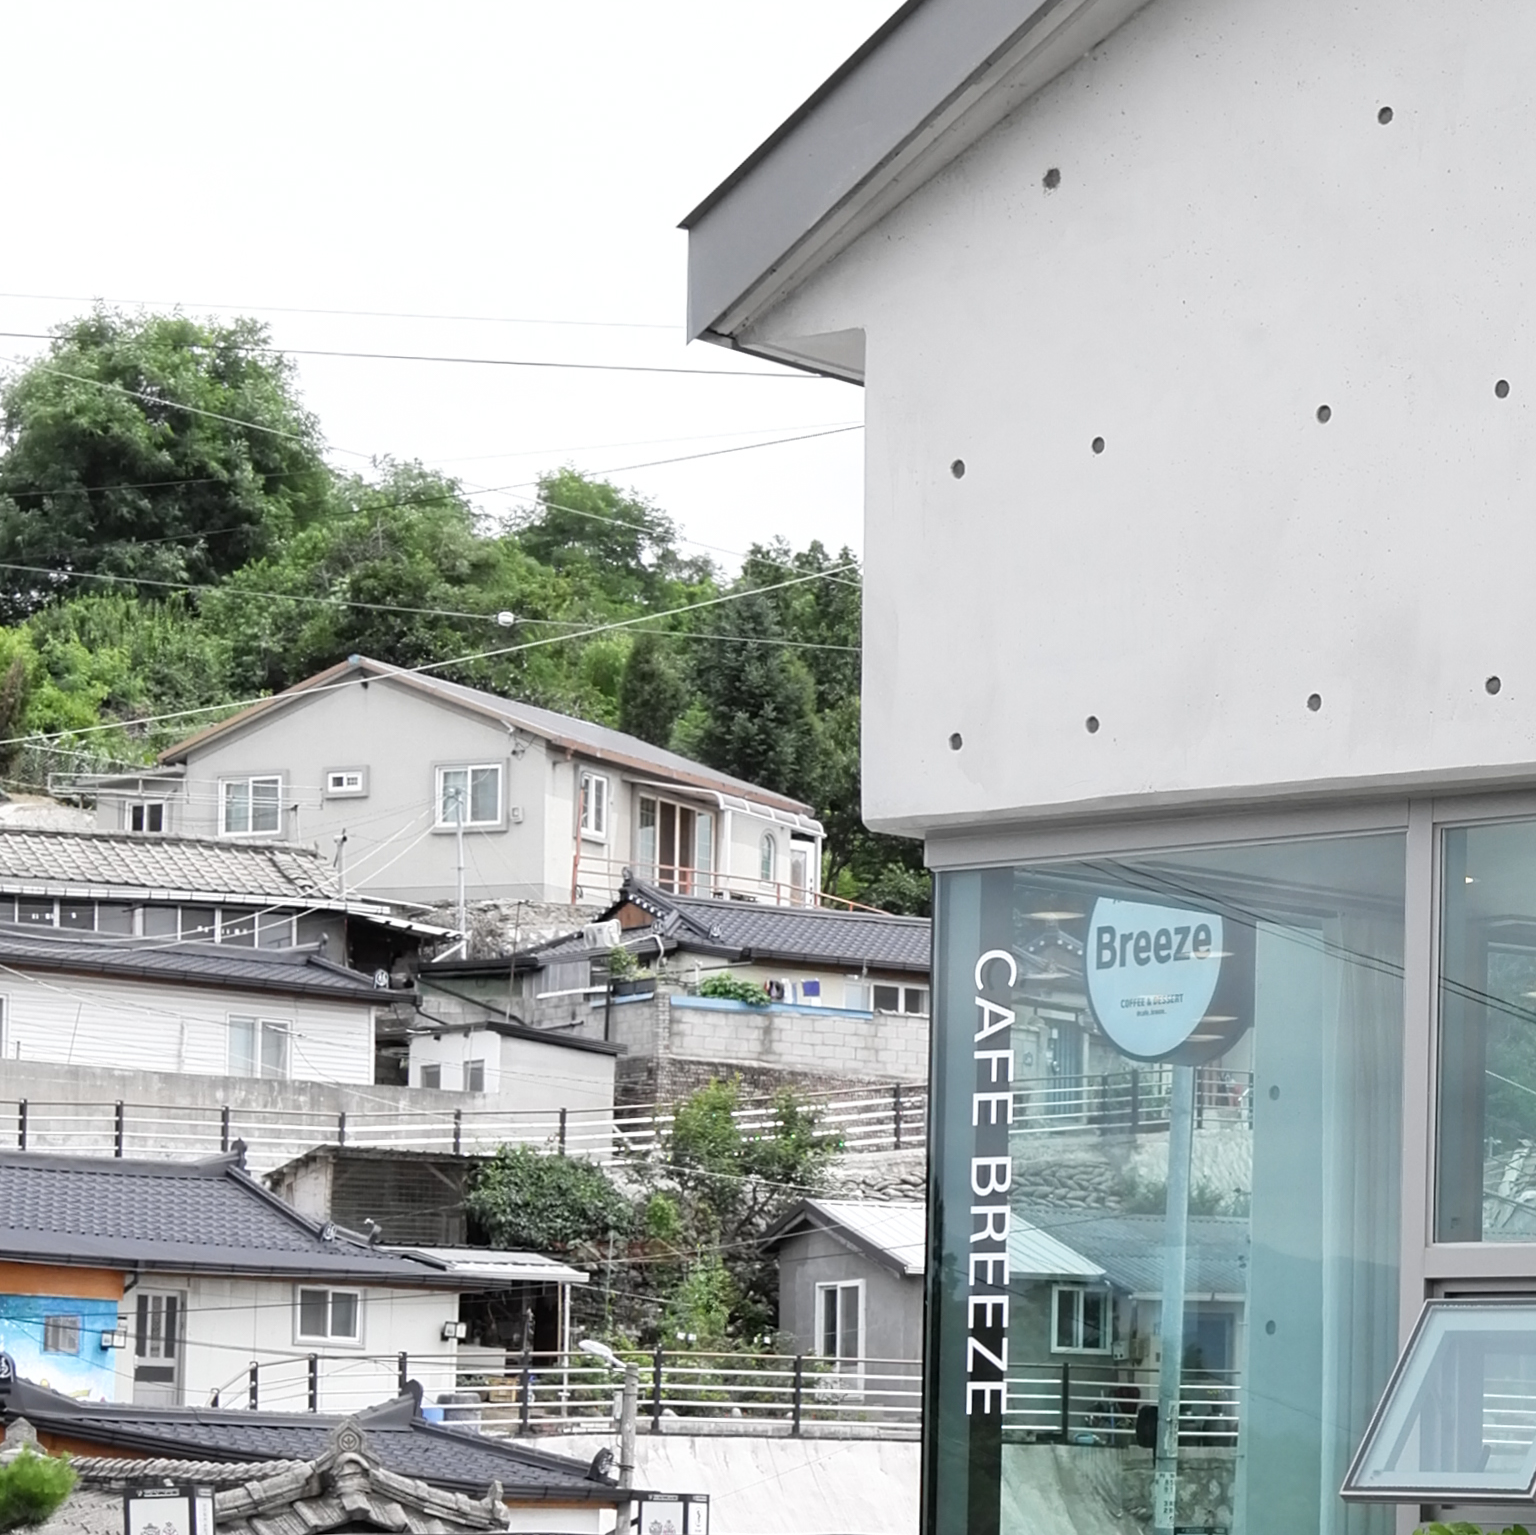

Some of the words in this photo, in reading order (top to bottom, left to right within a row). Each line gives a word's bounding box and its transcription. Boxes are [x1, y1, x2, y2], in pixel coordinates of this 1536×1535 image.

[1096, 923, 1212, 970] Breeze
[1120, 997, 1145, 1008] COFFEE
[1153, 993, 1184, 1005] DESSERT
[972, 949, 1018, 1127] CAFE
[965, 1155, 1012, 1416] BREEZE
